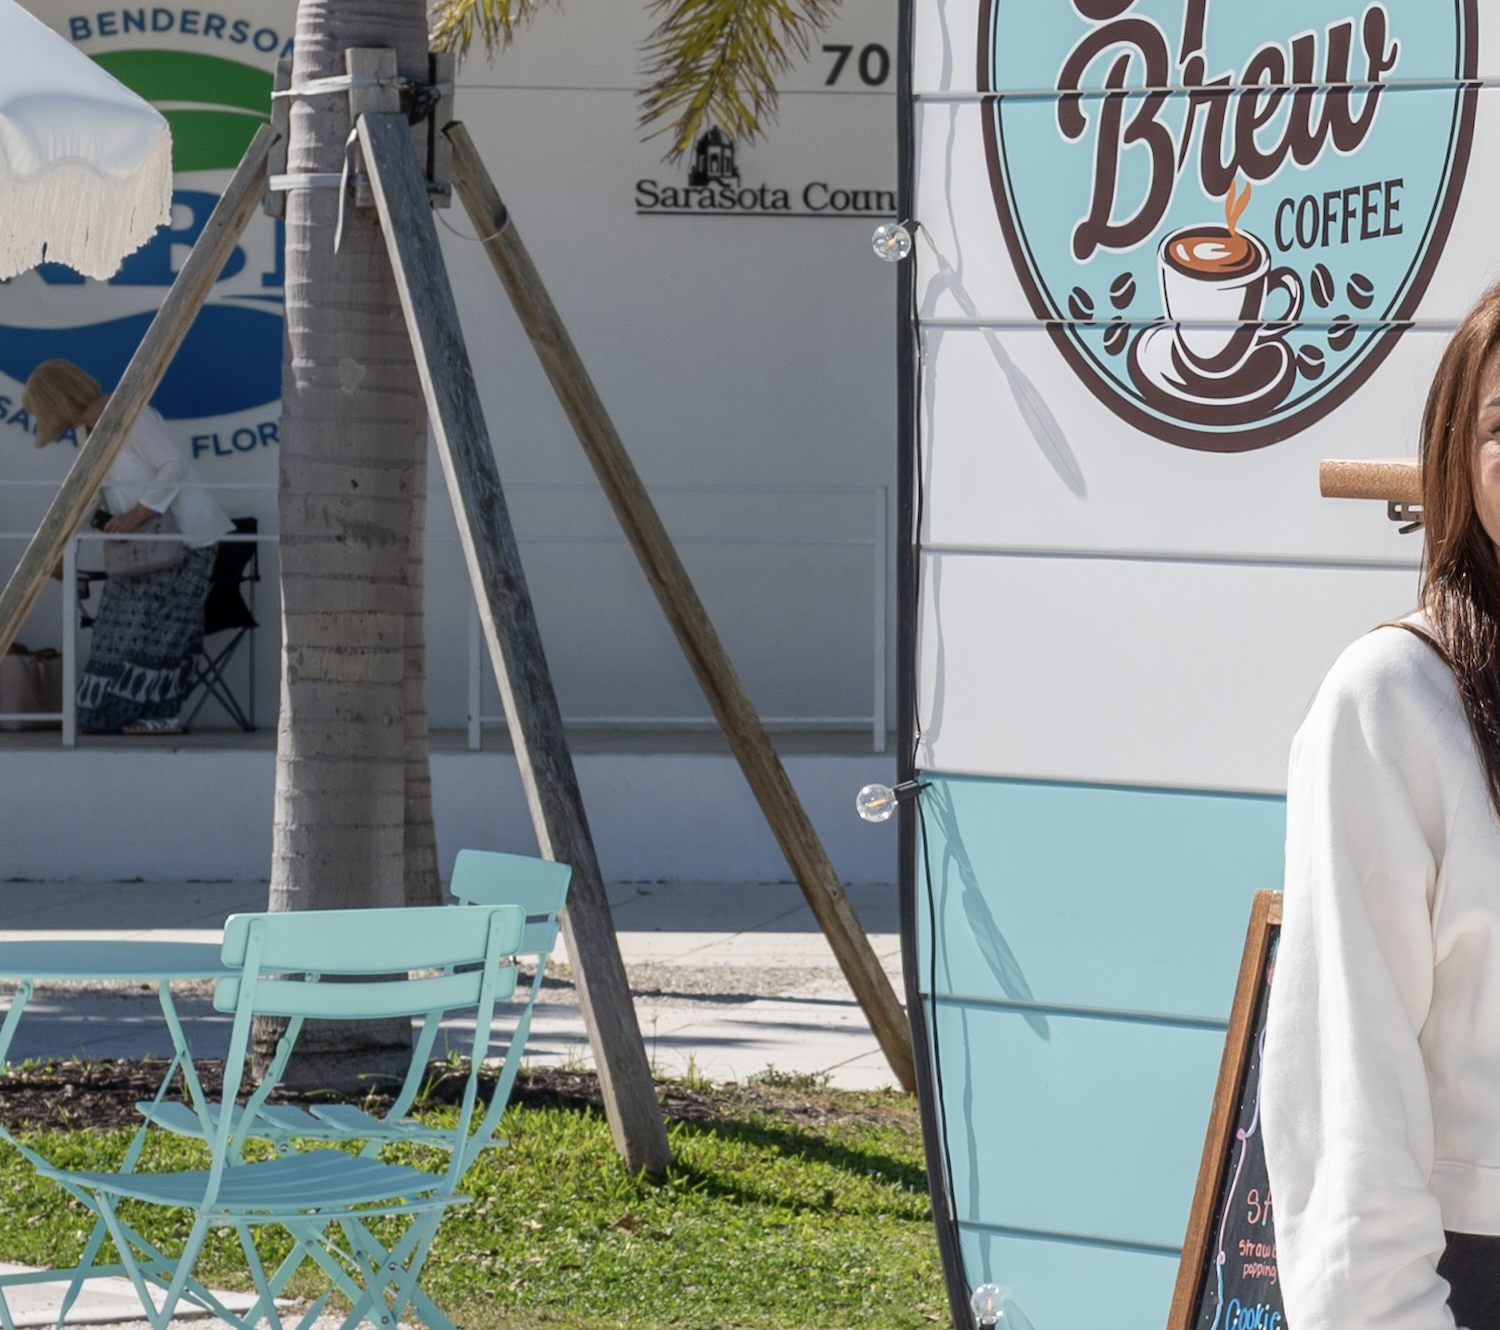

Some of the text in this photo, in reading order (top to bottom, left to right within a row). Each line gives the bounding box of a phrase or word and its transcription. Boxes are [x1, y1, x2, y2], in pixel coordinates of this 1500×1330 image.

[822, 43, 890, 86] 70
[1056, 4, 1398, 263] Brew
[635, 180, 897, 211] Sarasota Coun
[1273, 179, 1404, 252] COFFEE
[191, 422, 280, 459] FLOR
[1239, 1238, 1276, 1257] straw
[1243, 1261, 1277, 1285] popping
